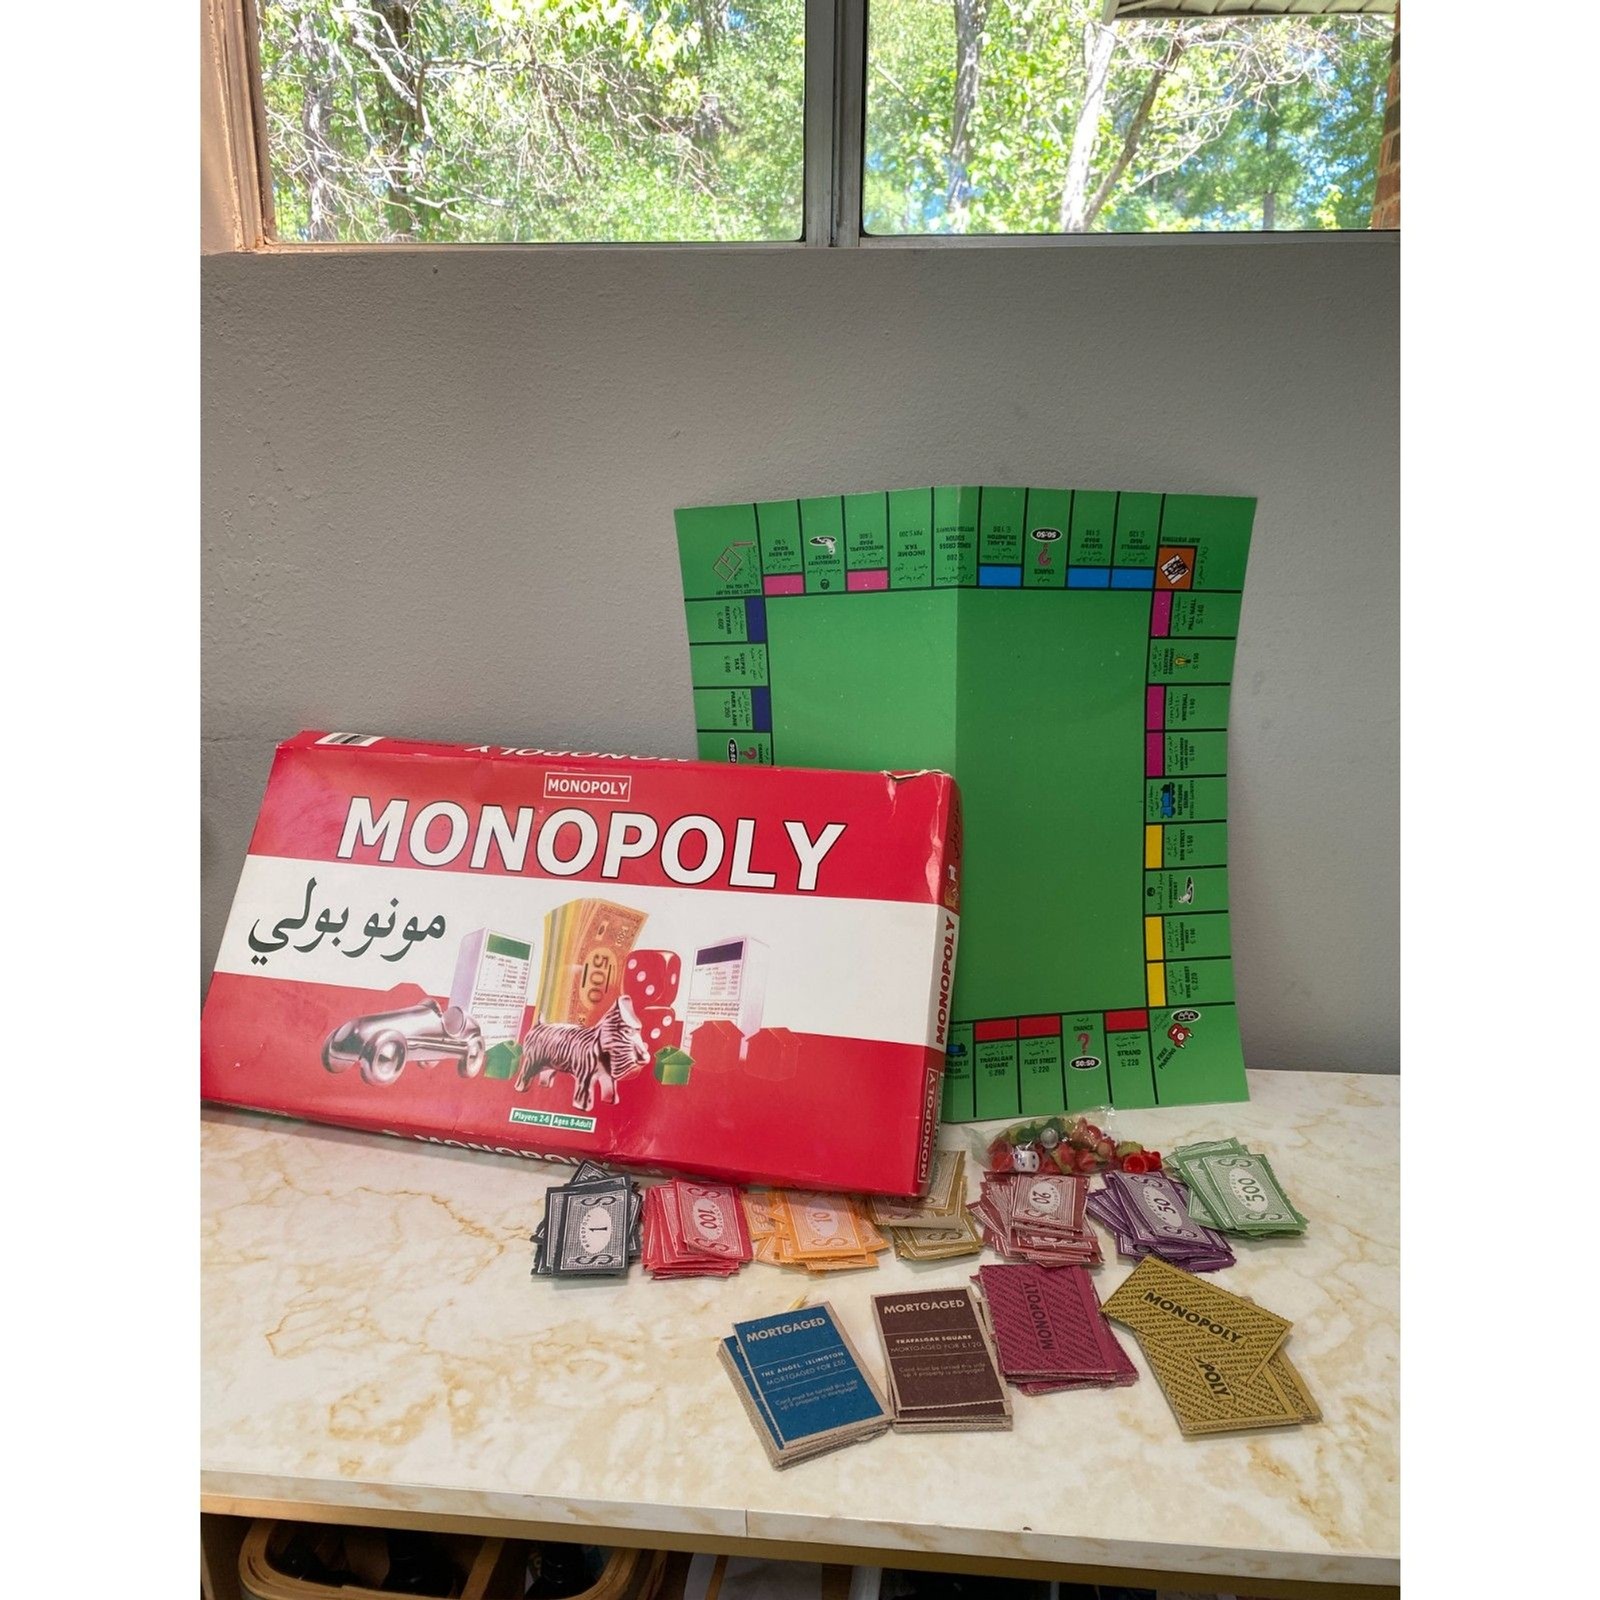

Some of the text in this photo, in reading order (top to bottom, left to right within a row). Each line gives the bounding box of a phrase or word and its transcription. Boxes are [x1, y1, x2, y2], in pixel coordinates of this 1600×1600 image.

[547, 778, 628, 796] MONOPOLY
[337, 796, 847, 890] MONOPOLY
[587, 953, 610, 1005] 500
[936, 915, 955, 1045] MONOPOLY
[980, 1055, 1013, 1064] TRAFALGAR
[1156, 1047, 1168, 1061] FREE
[513, 1111, 538, 1122] Players
[553, 1116, 569, 1127] Ages
[921, 1073, 936, 1178] MONOPOLY
[1032, 1190, 1052, 1205] 20
[1237, 1177, 1265, 1204] 500
[812, 1211, 833, 1222] 10
[1152, 1197, 1177, 1215] 50
[698, 1208, 718, 1229] 100
[883, 1299, 965, 1315] MORTGAGED
[1022, 1281, 1054, 1351] MONOPOLY
[1143, 1290, 1242, 1344] MONOPOLY
[745, 1317, 826, 1343] MORTGAGED
[895, 1336, 940, 1345] TRAFALGAR
[890, 1343, 941, 1353] MORTGAGED
[761, 1370, 775, 1378] THE
[805, 1351, 844, 1368] ISLINGTON
[766, 1368, 816, 1386] MORTGAGED
[817, 1363, 831, 1372] FOR
[1195, 1358, 1231, 1396] POLY
